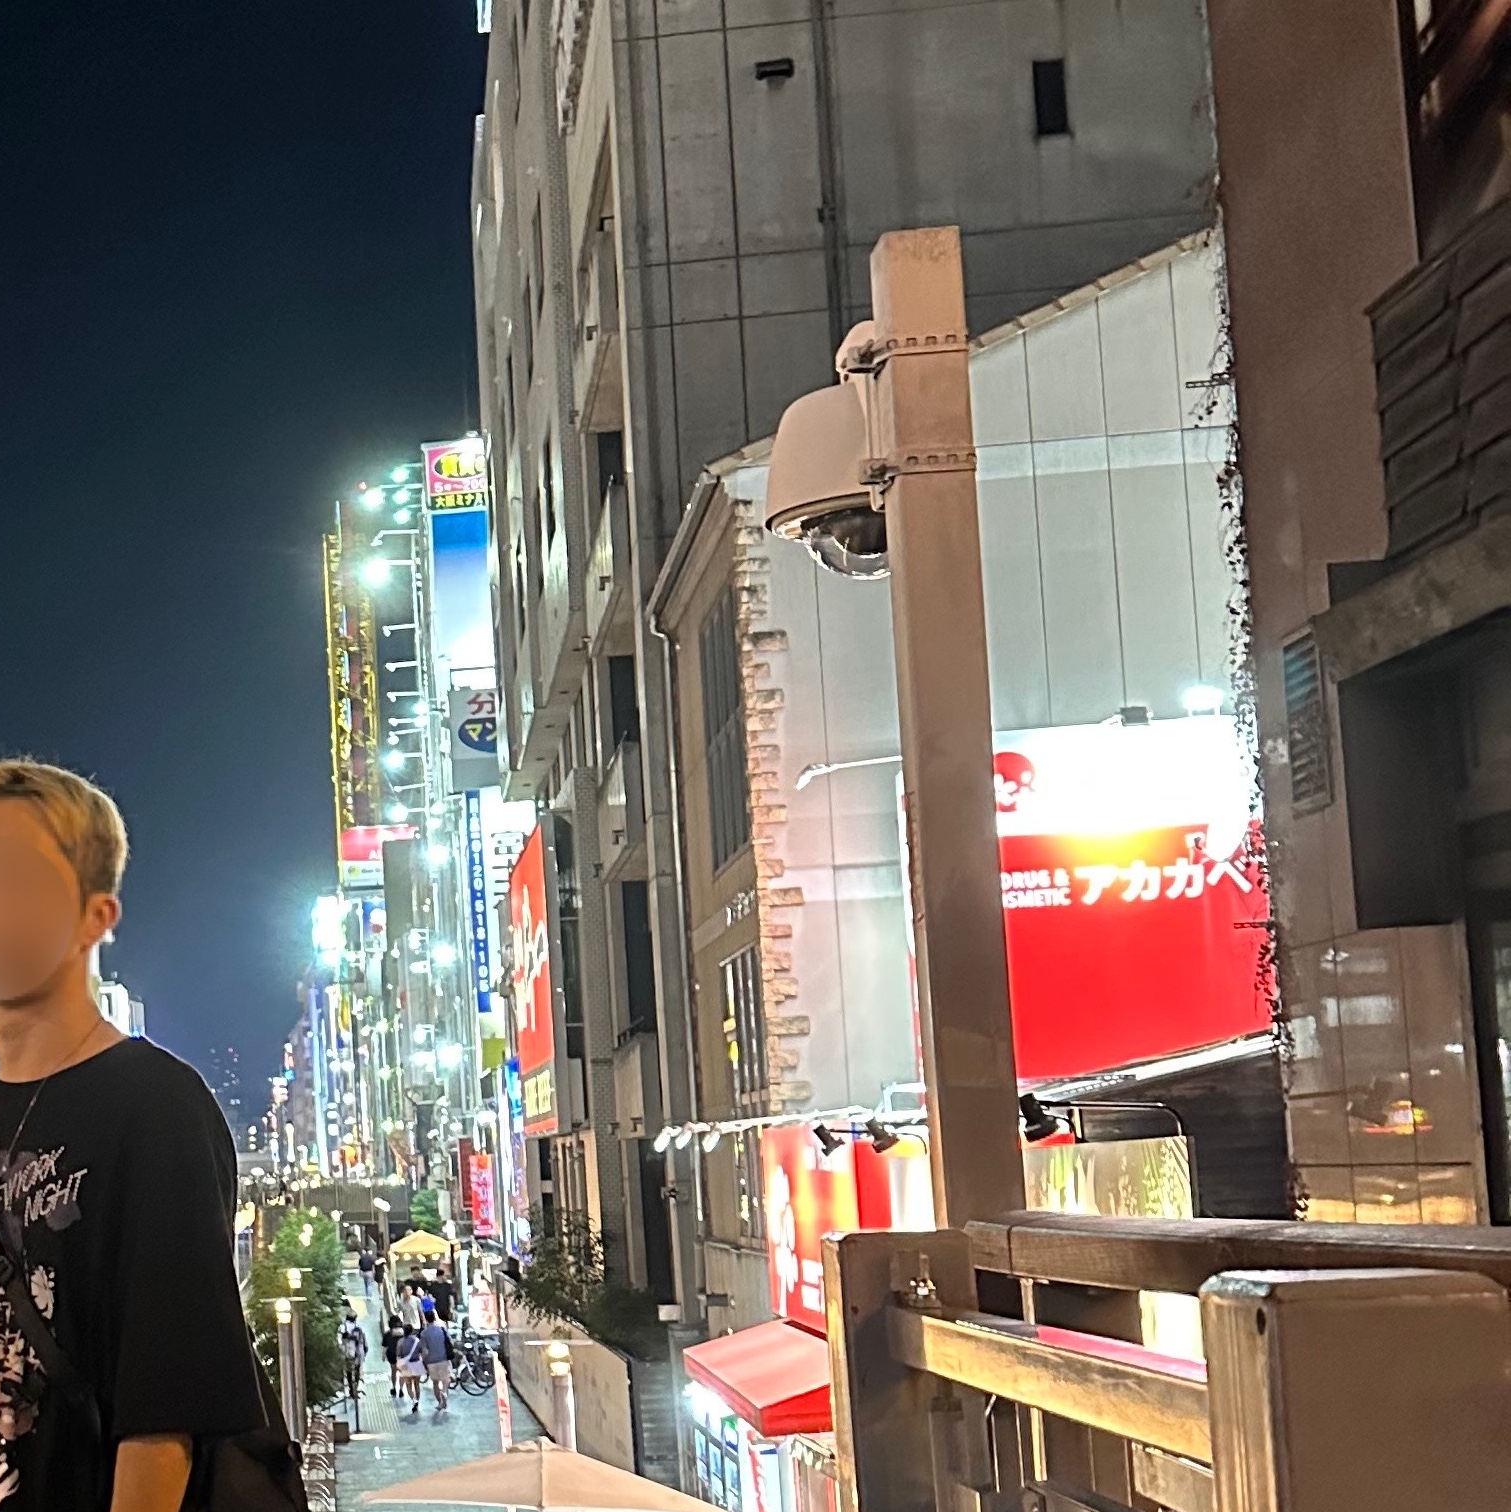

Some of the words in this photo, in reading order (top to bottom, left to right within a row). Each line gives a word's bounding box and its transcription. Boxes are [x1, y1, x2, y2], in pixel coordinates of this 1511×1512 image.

[1001, 870, 1051, 888] DRUG
[1053, 867, 1070, 887] &
[1074, 857, 1253, 905] アカカベ
[1002, 887, 1072, 908] SMETIC
